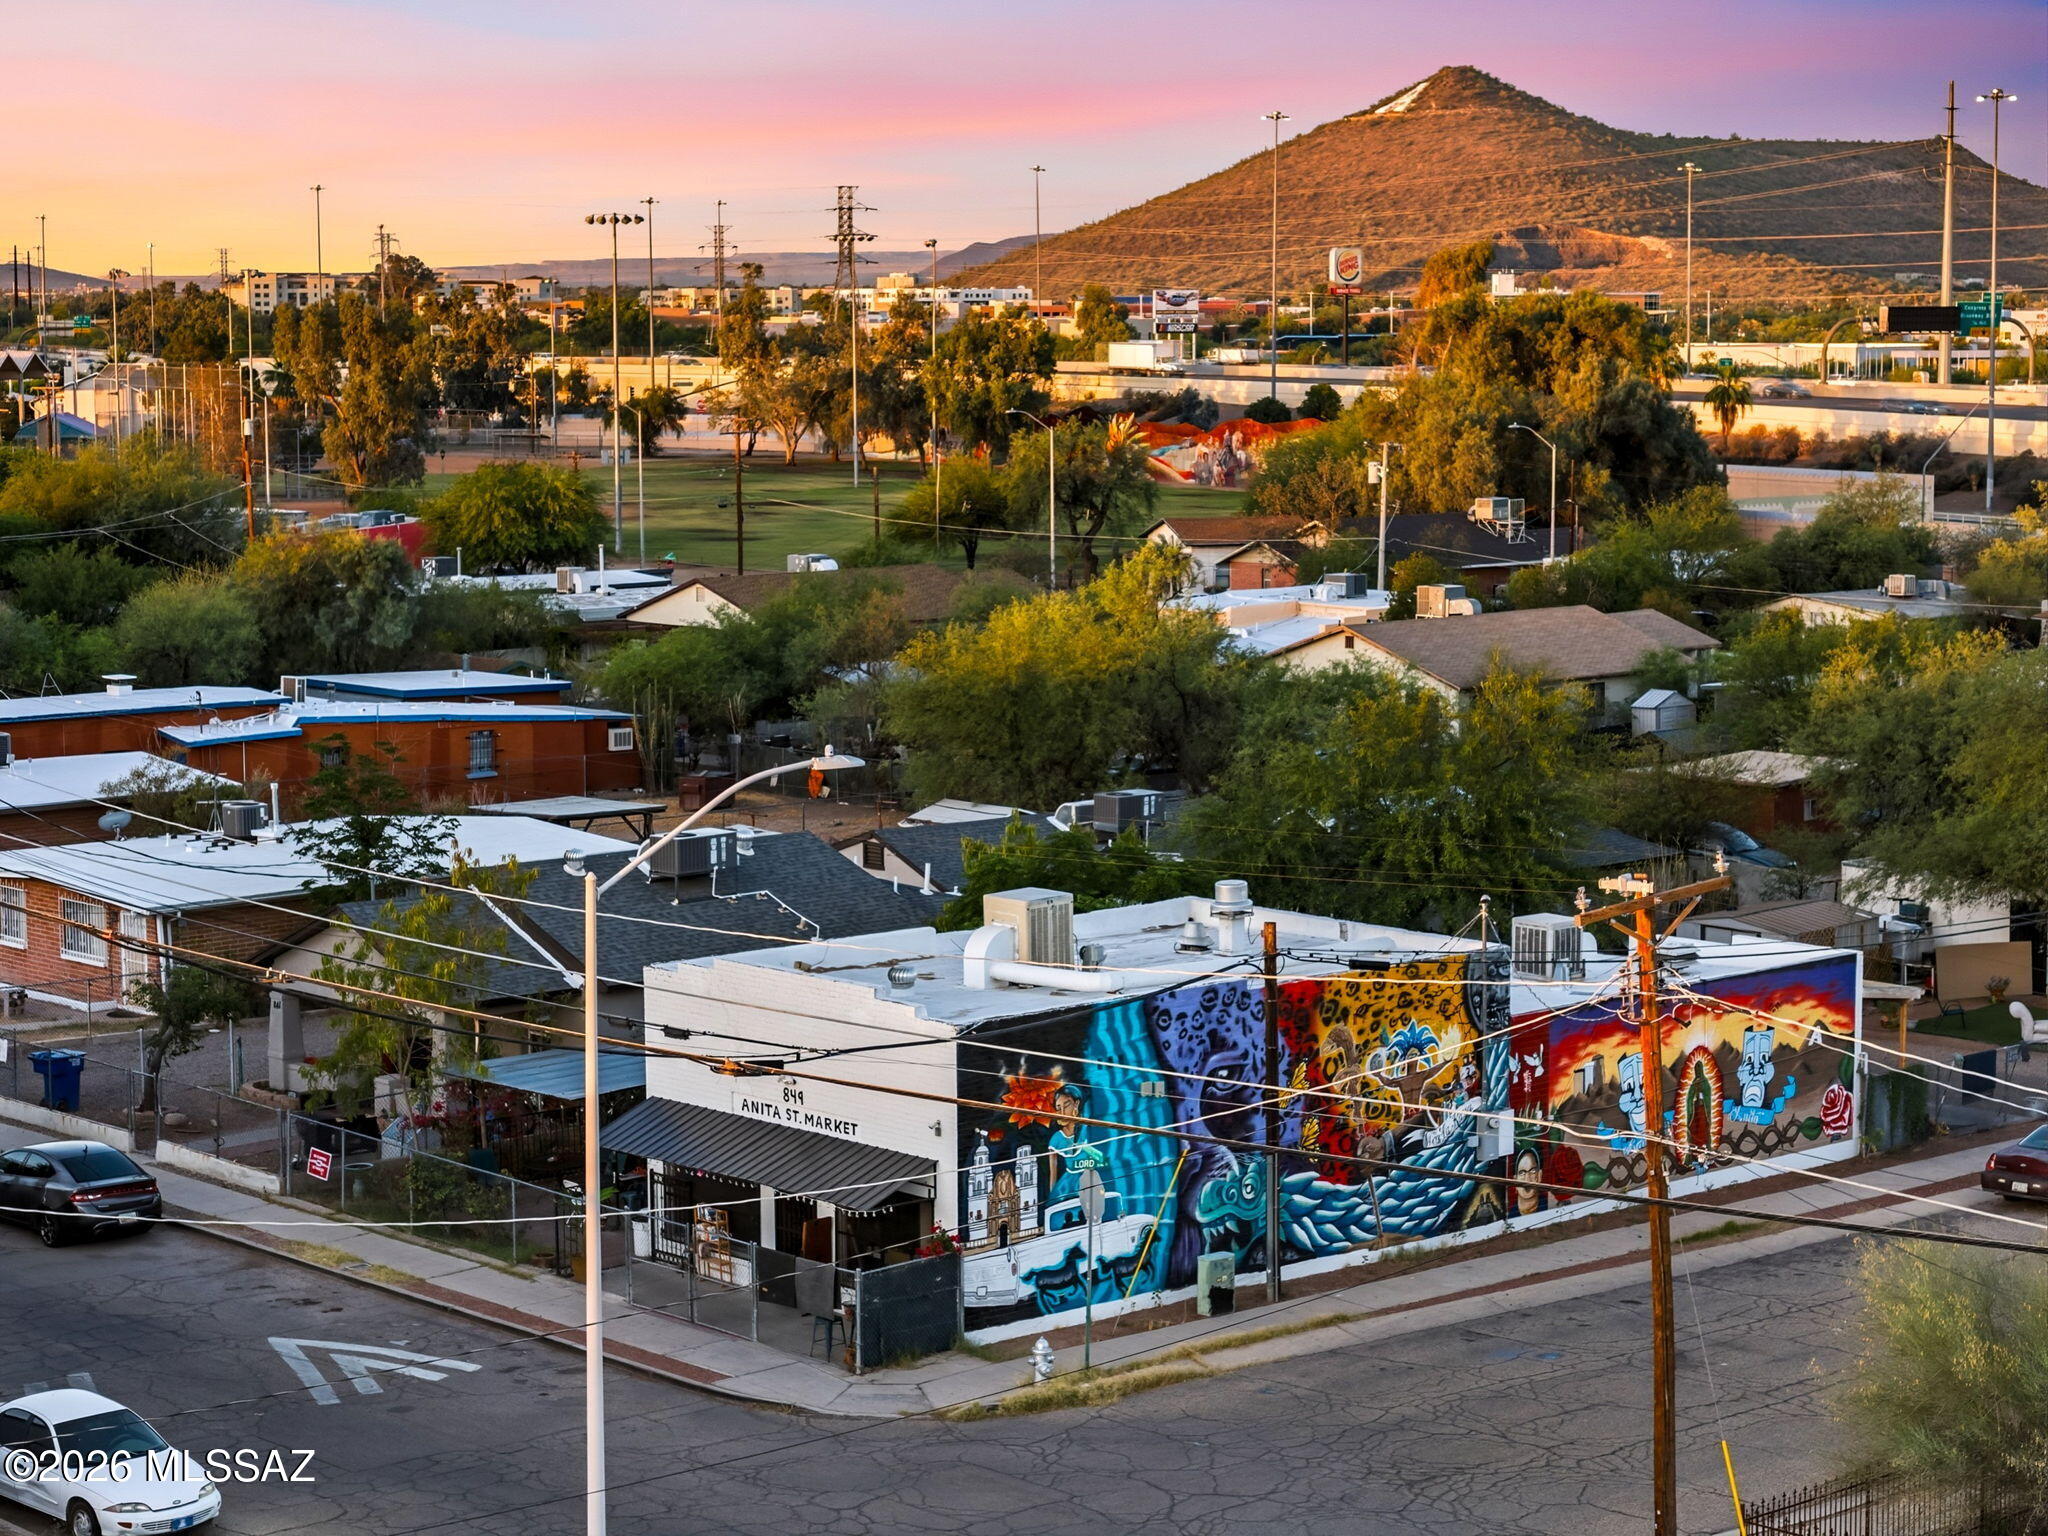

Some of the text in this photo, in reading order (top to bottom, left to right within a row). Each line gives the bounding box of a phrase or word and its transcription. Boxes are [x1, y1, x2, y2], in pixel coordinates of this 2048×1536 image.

[1340, 262, 1359, 274] KING
[783, 1087, 804, 1105] 849
[742, 1099, 858, 1136] ANITA ST. MARKET
[1074, 1159, 1095, 1168] LORD
